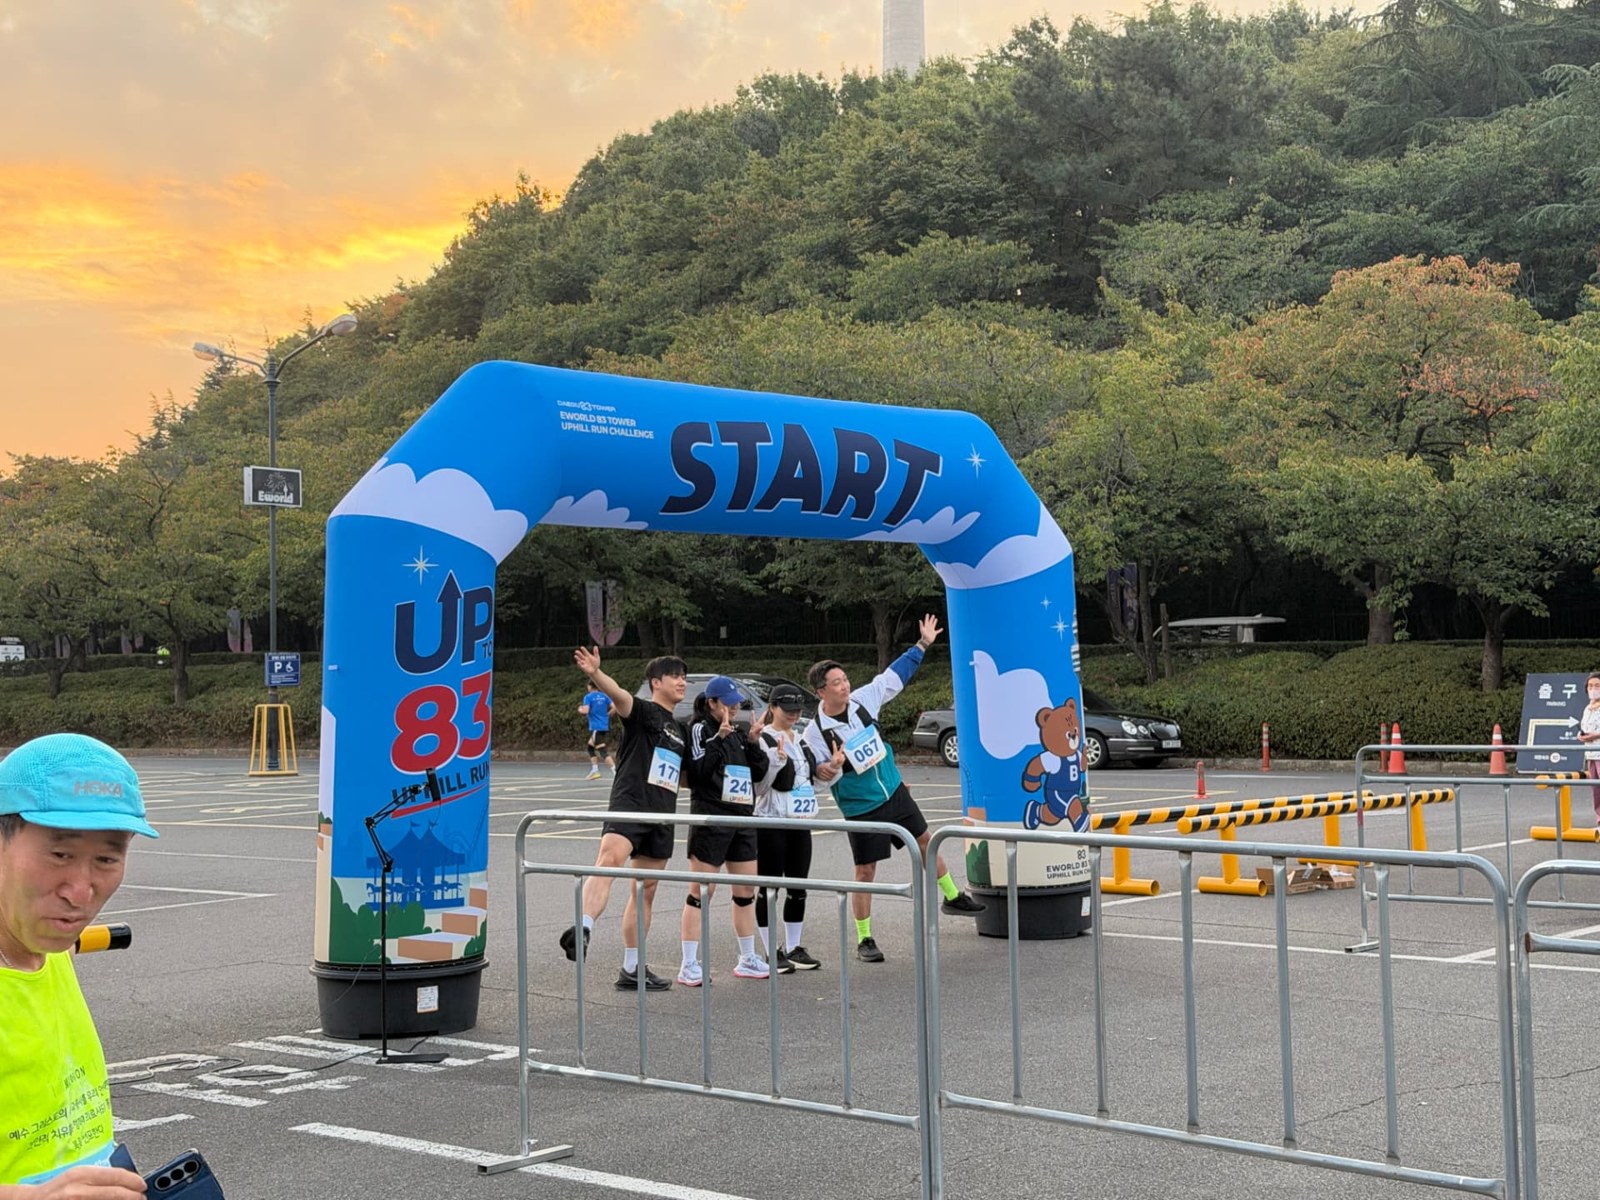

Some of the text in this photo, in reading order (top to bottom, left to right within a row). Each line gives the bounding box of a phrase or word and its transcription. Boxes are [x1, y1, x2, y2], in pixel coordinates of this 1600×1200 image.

[560, 410, 596, 423] EWORLD
[607, 416, 637, 427] TOWER
[561, 421, 655, 440] UPHILL RUN CHALLENGE
[659, 420, 943, 527] START
[394, 569, 494, 676] UP
[274, 661, 283, 673] P
[390, 669, 492, 775] 83
[854, 738, 880, 763] 067
[658, 763, 679, 783] 177
[1069, 764, 1079, 781] B
[73, 780, 123, 799] HOKA
[729, 779, 752, 796] 247
[793, 799, 816, 813] 227
[1077, 849, 1086, 860] 83
[1046, 862, 1080, 872] EWORLD
